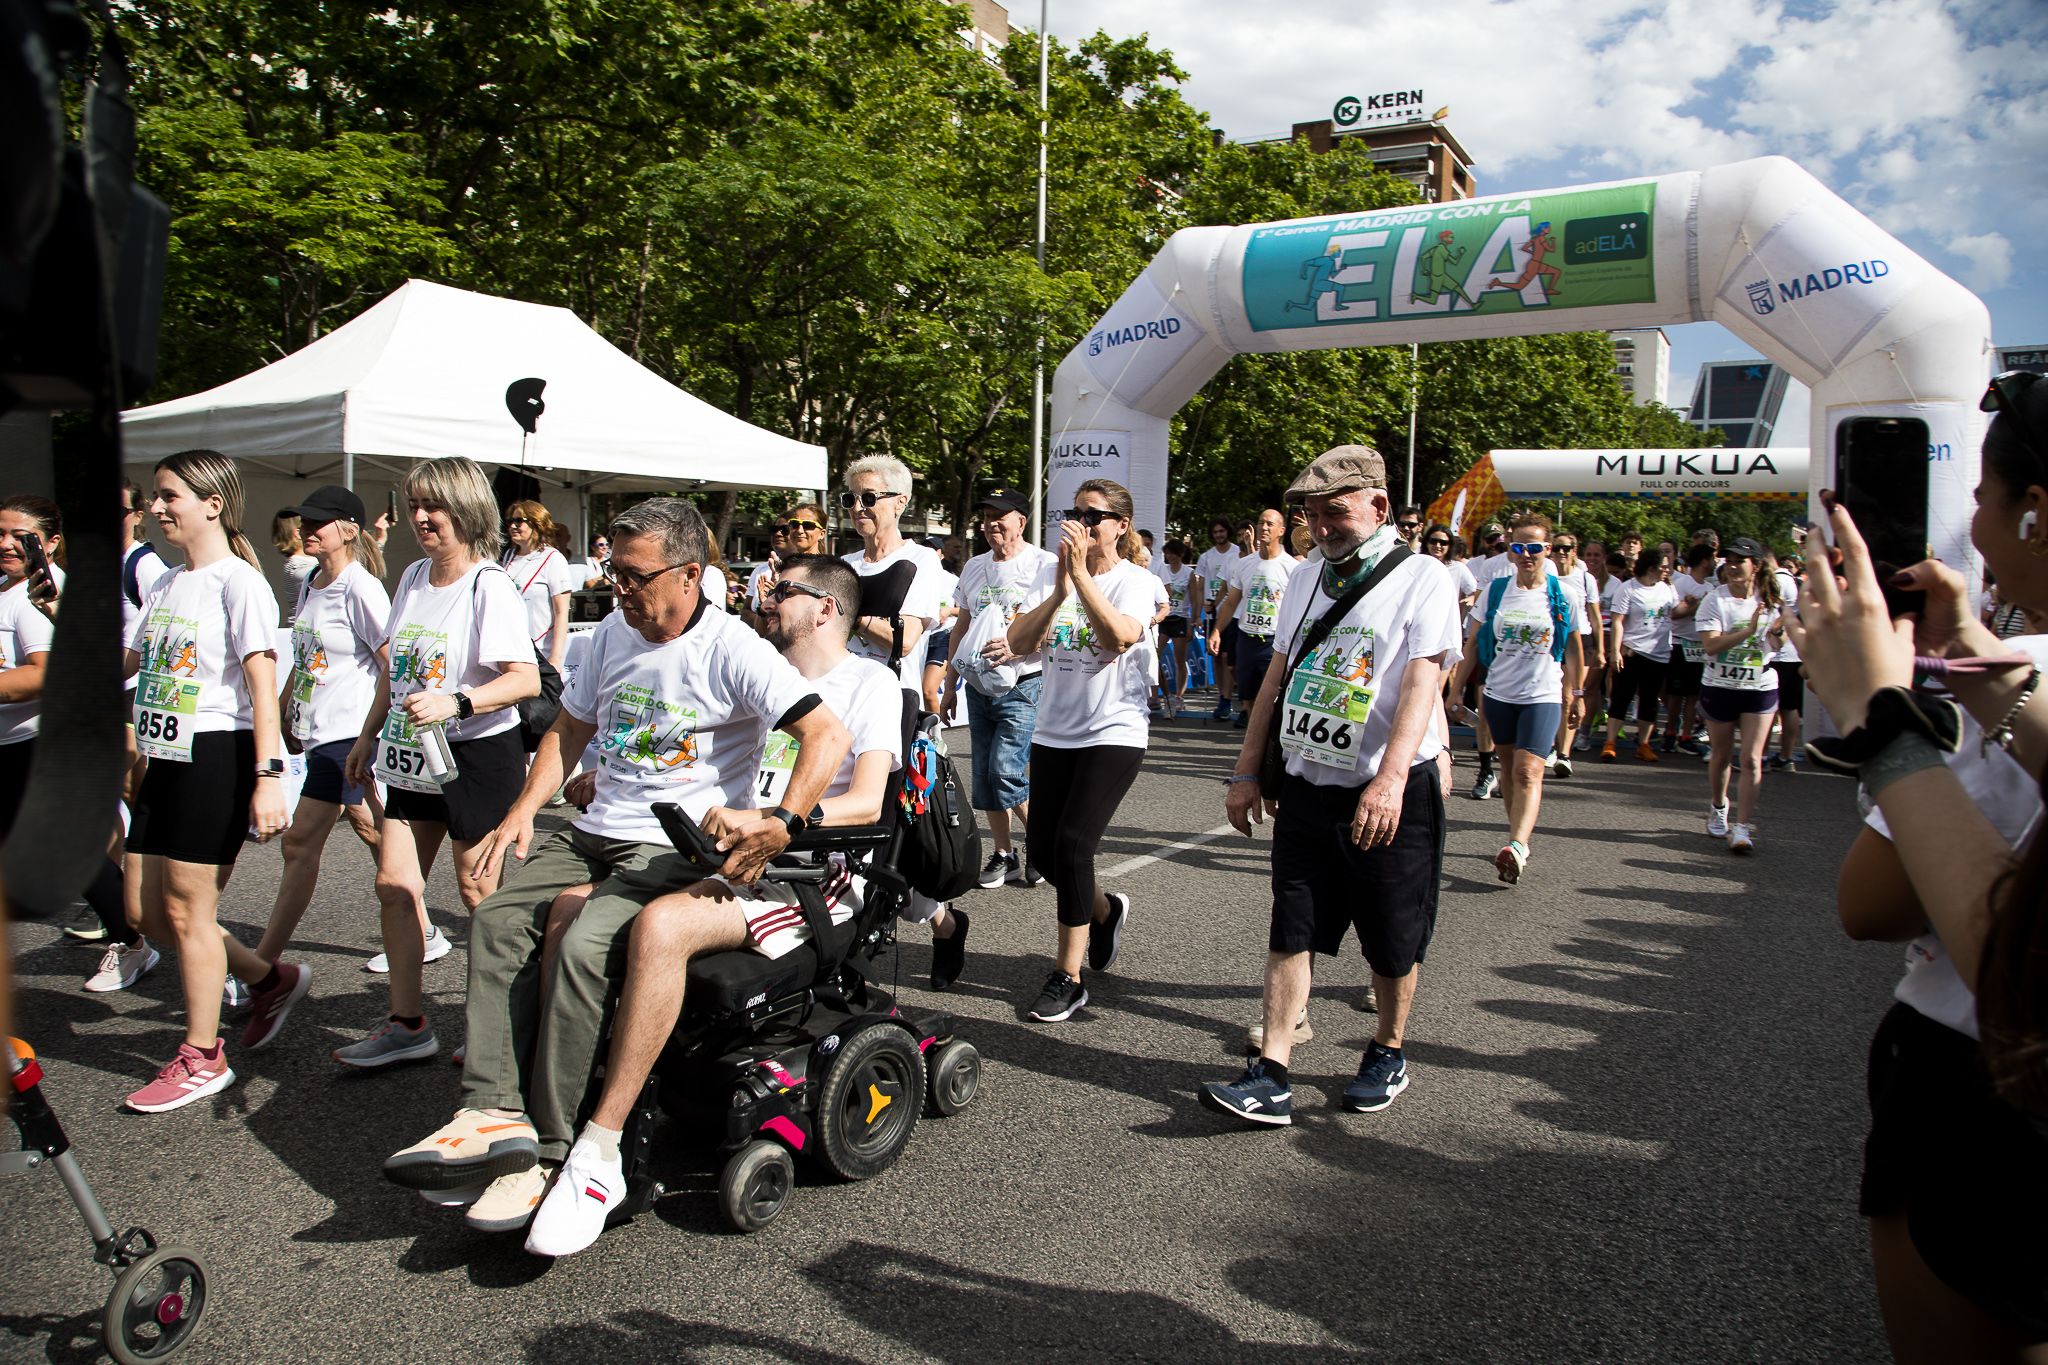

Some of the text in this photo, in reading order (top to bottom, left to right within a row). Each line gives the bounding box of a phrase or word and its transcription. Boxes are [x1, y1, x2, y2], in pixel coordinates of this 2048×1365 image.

[1368, 89, 1423, 109] KERN
[1333, 211, 1432, 232] MADRID
[1438, 203, 1495, 220] CON
[1497, 199, 1532, 214] LA
[1316, 216, 1551, 321] ELA
[1778, 259, 1890, 303] MADRID
[1107, 317, 1181, 348] MADRID
[1596, 453, 1779, 476] MUKUA
[1640, 480, 1730, 489] FULL OF COLOURS
[1246, 613, 1272, 627] 1284
[1340, 626, 1359, 635] CON
[1360, 626, 1374, 636] LA
[1720, 665, 1756, 681] 1471
[615, 690, 697, 719] MADRID CON LA
[626, 683, 655, 697] Carrera
[1298, 681, 1350, 714] ELA
[138, 710, 178, 742] 858
[1286, 708, 1352, 750] 1466
[386, 745, 426, 777] 857
